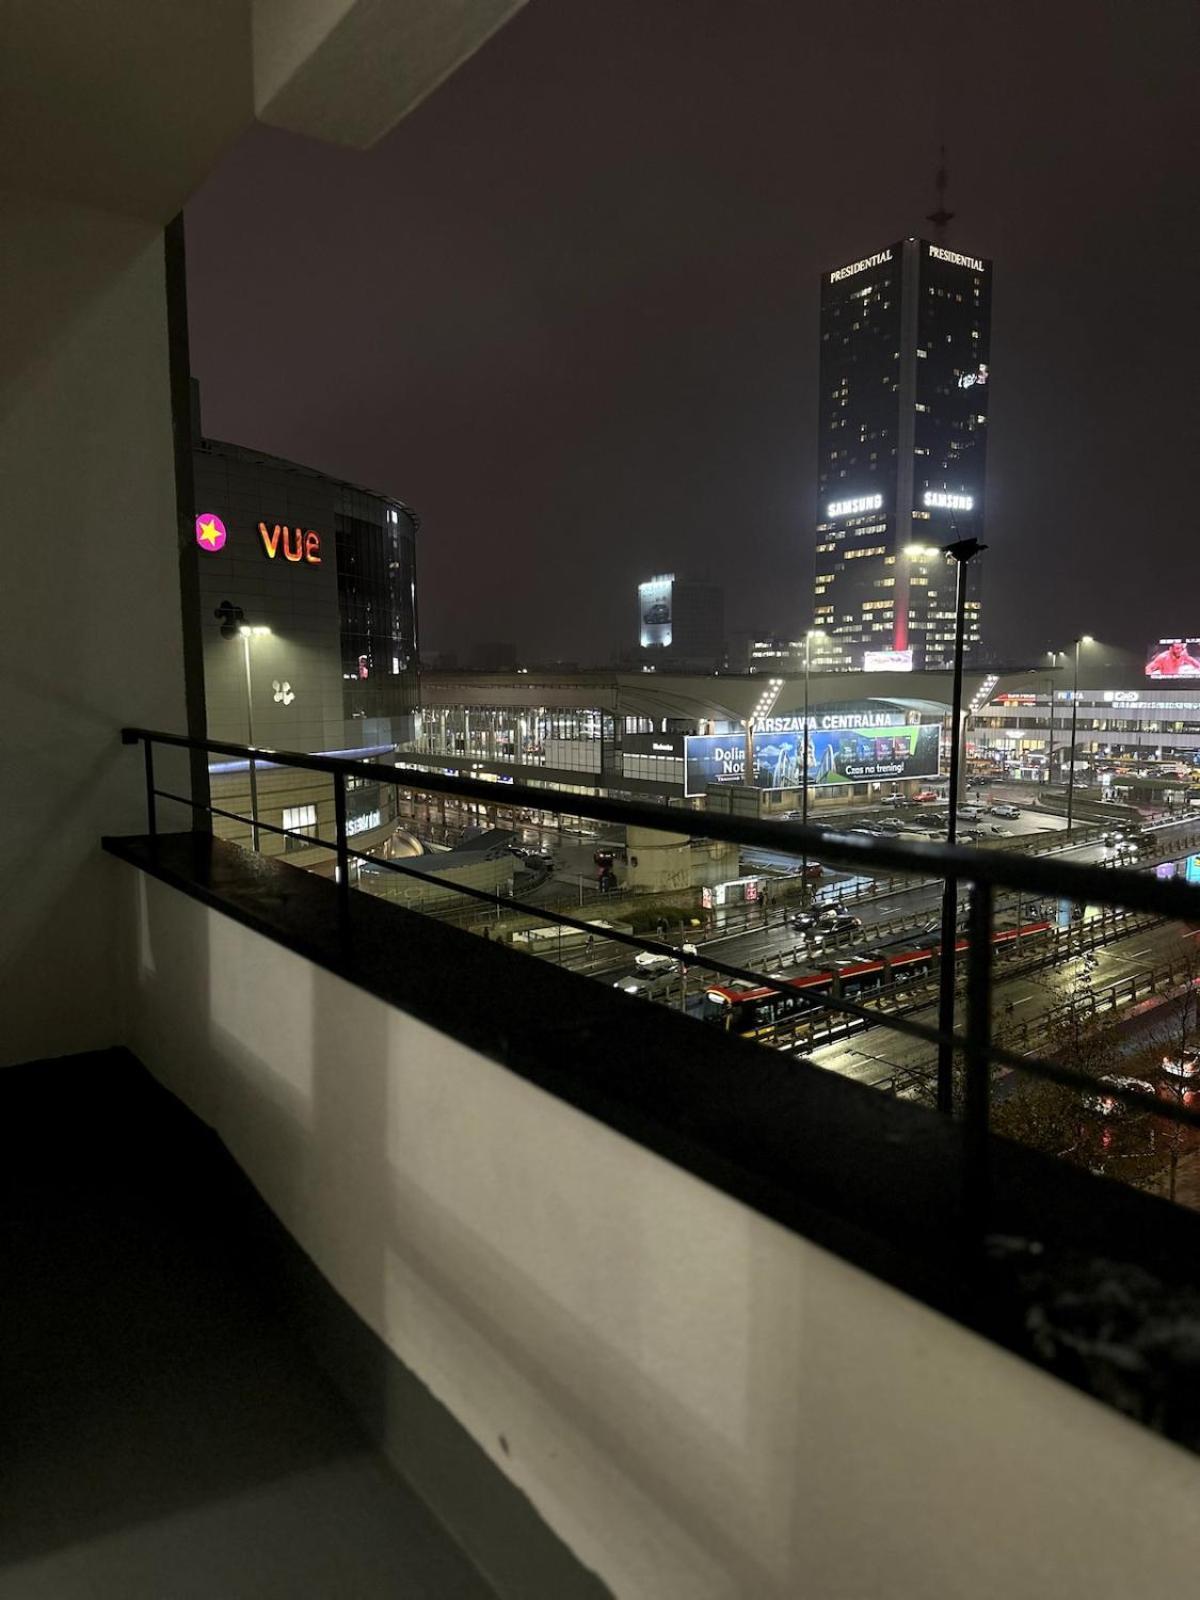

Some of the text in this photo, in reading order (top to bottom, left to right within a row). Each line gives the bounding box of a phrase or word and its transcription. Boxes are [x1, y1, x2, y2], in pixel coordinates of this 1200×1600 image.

[830, 249, 893, 284] PRESIDENTIAL
[929, 245, 985, 273] PRESIDENTIAL
[827, 493, 883, 518] SAMSUNG
[924, 490, 974, 511] SAMSUNG
[752, 711, 892, 734] ARSZAWA CENTRALNA
